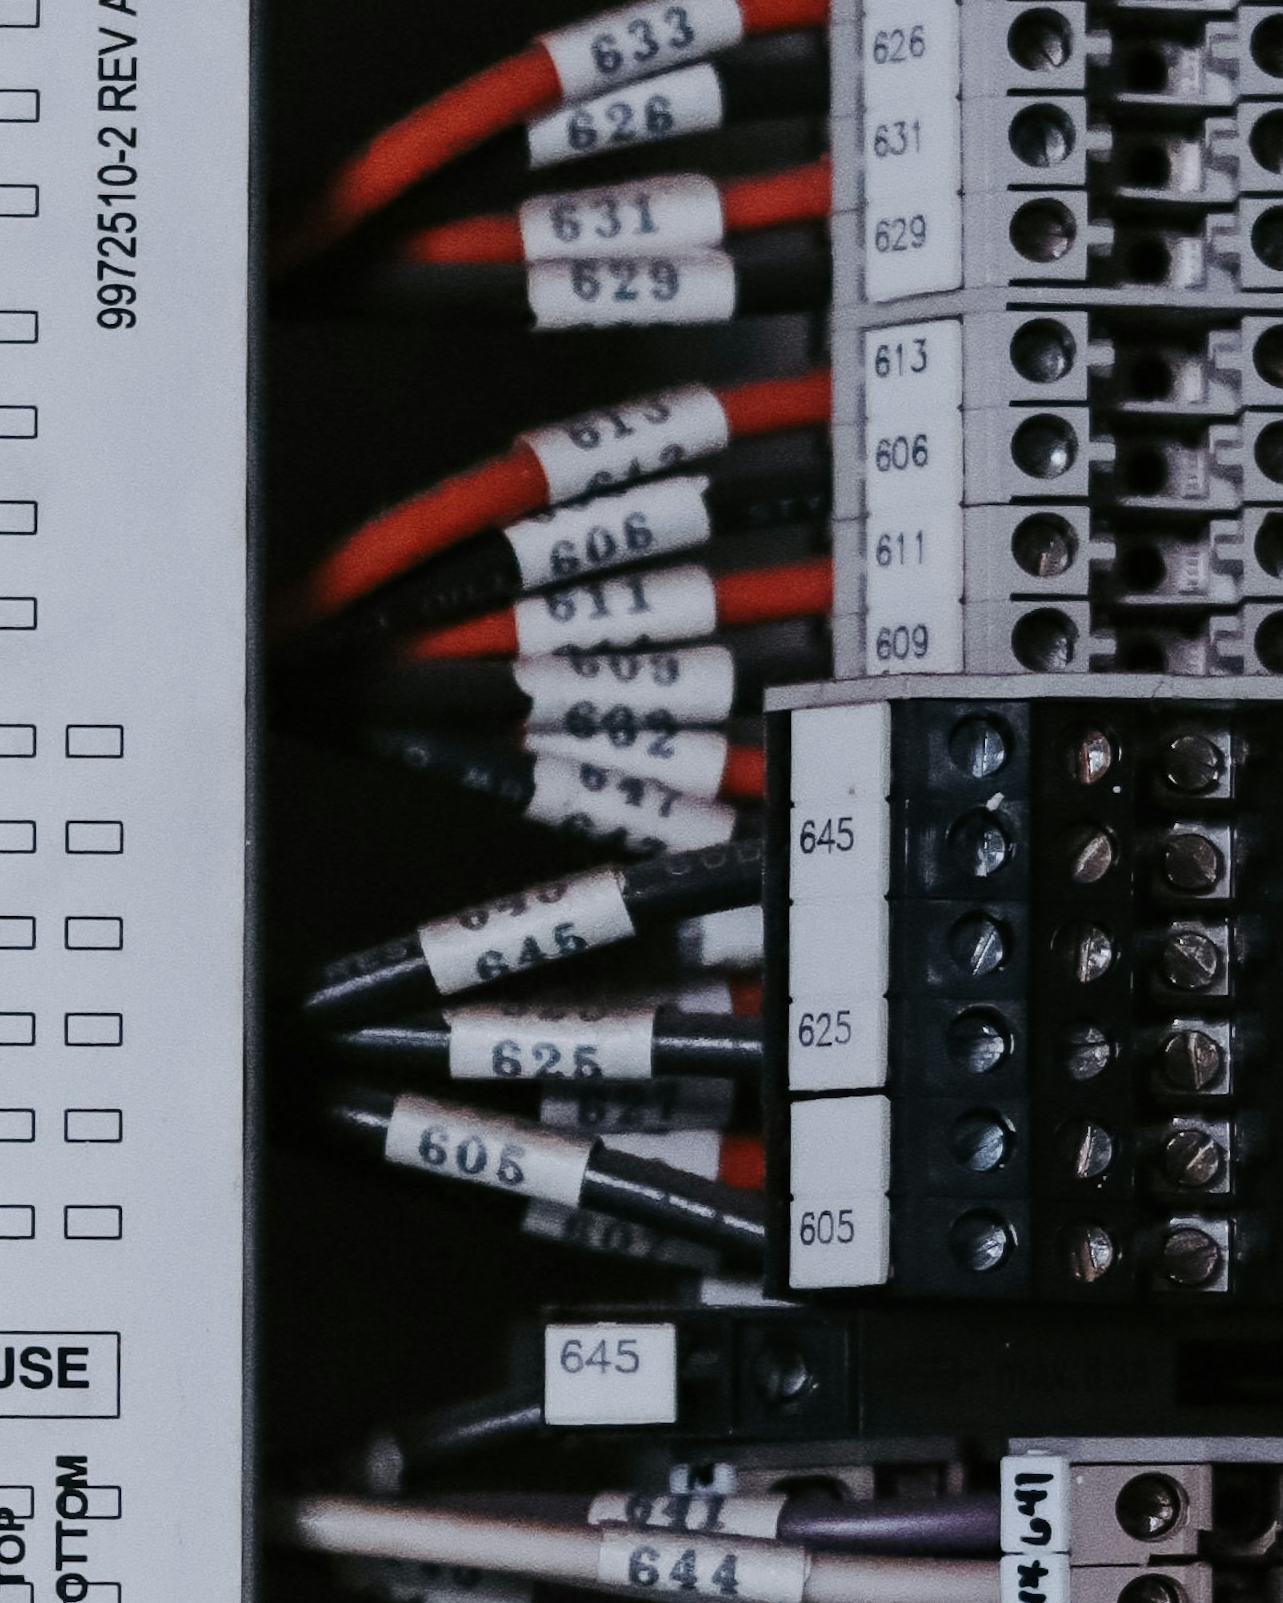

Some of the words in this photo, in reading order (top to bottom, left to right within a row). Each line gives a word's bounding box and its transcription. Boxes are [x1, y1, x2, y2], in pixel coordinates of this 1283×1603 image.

[592, 7, 696, 74] 633
[873, 26, 926, 64] 626
[98, 27, 137, 111] REV
[568, 97, 674, 152] 626
[873, 120, 923, 158] 631
[97, 127, 137, 329] 9972510-2
[550, 194, 659, 243] 631
[875, 214, 927, 252] 629
[571, 259, 680, 302] 629
[875, 338, 928, 379] 613
[876, 434, 928, 472] 606
[876, 531, 925, 567] 611
[876, 624, 929, 661] 609
[799, 816, 855, 855] 645
[797, 1010, 852, 1049] 625
[418, 1125, 527, 1187] 605
[799, 1209, 855, 1247] 605
[559, 1339, 641, 1376] 645
[628, 1546, 739, 1596] 644
